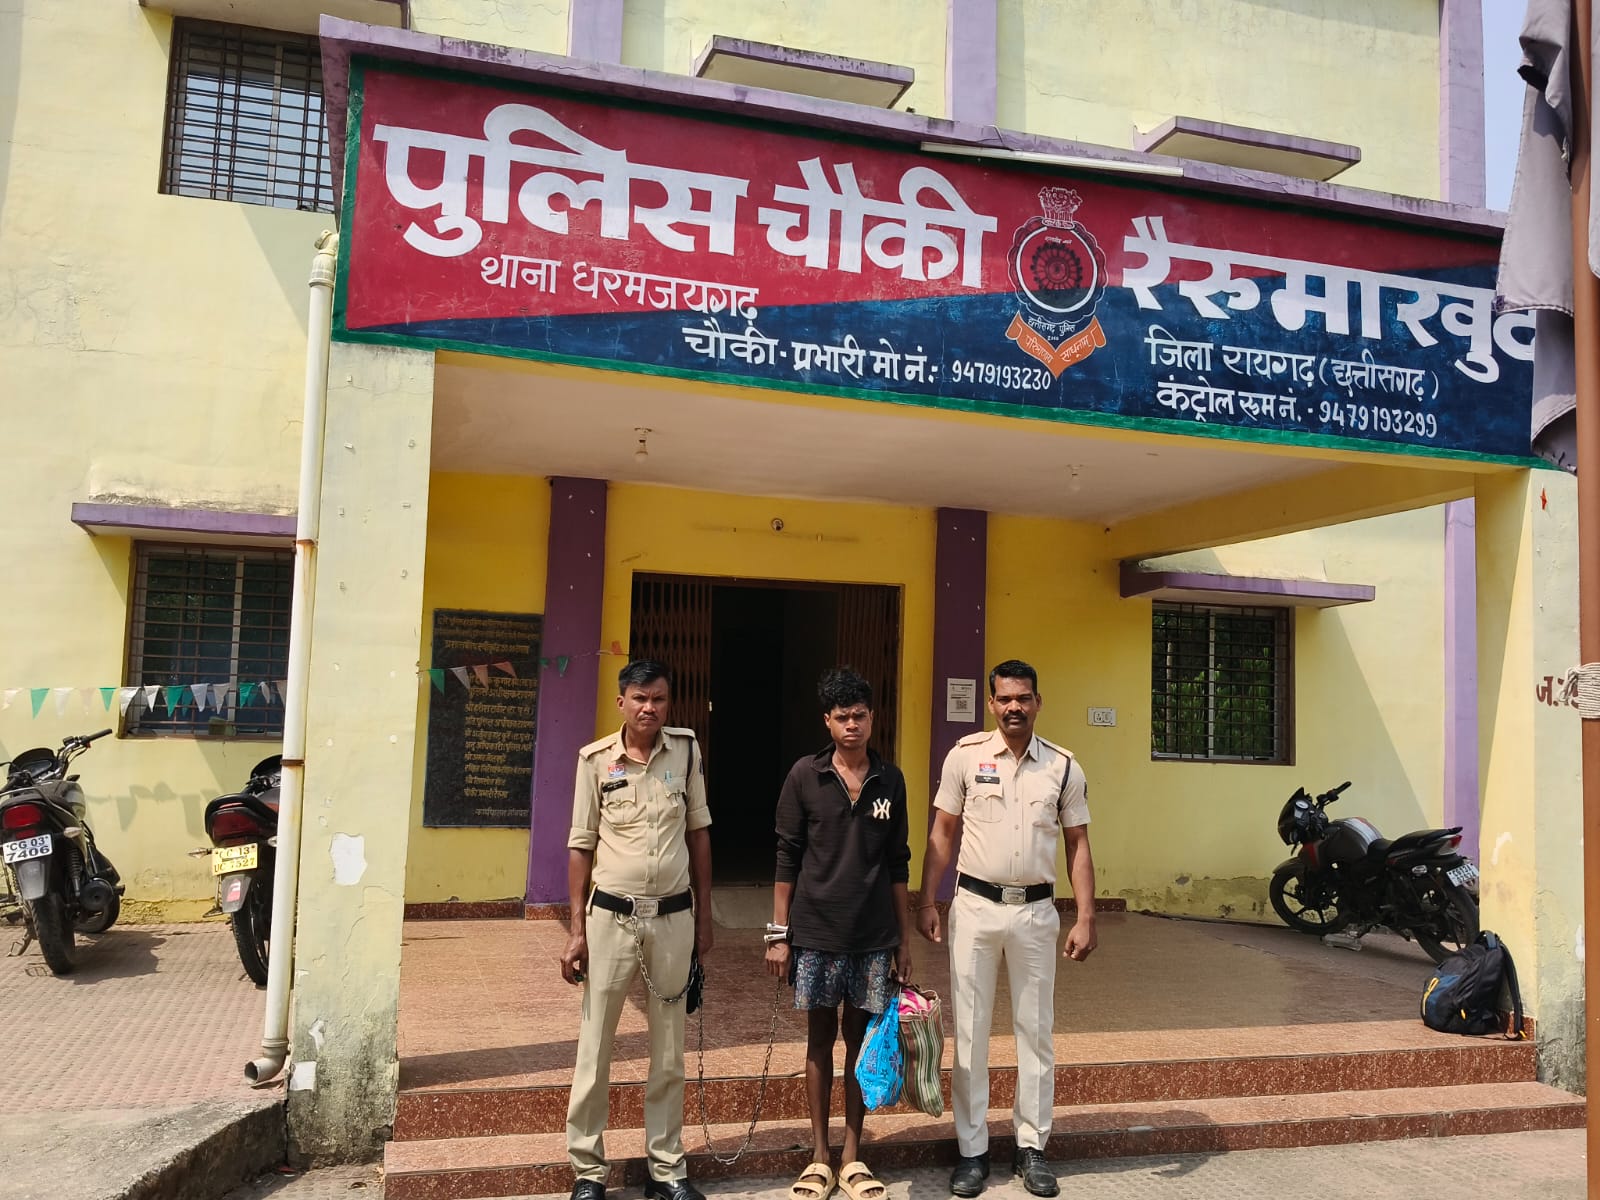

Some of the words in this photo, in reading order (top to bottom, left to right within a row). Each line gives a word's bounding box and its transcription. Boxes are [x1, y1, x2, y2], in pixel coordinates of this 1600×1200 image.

[373, 103, 749, 257] पुलिस
[758, 157, 998, 288] चौकी
[480, 254, 562, 294] थाना
[1144, 324, 1214, 371] जिला
[1222, 345, 1316, 387] रायगढ़
[952, 360, 1051, 390] 9479193230
[1156, 374, 1235, 422] कंट्रोल
[1319, 400, 1437, 438] 9479193299
[872, 797, 892, 820] NY
[6, 845, 50, 861] 7406
[10, 840, 28, 851] CG
[30, 836, 45, 847] 03
[239, 846, 250, 856] 13
